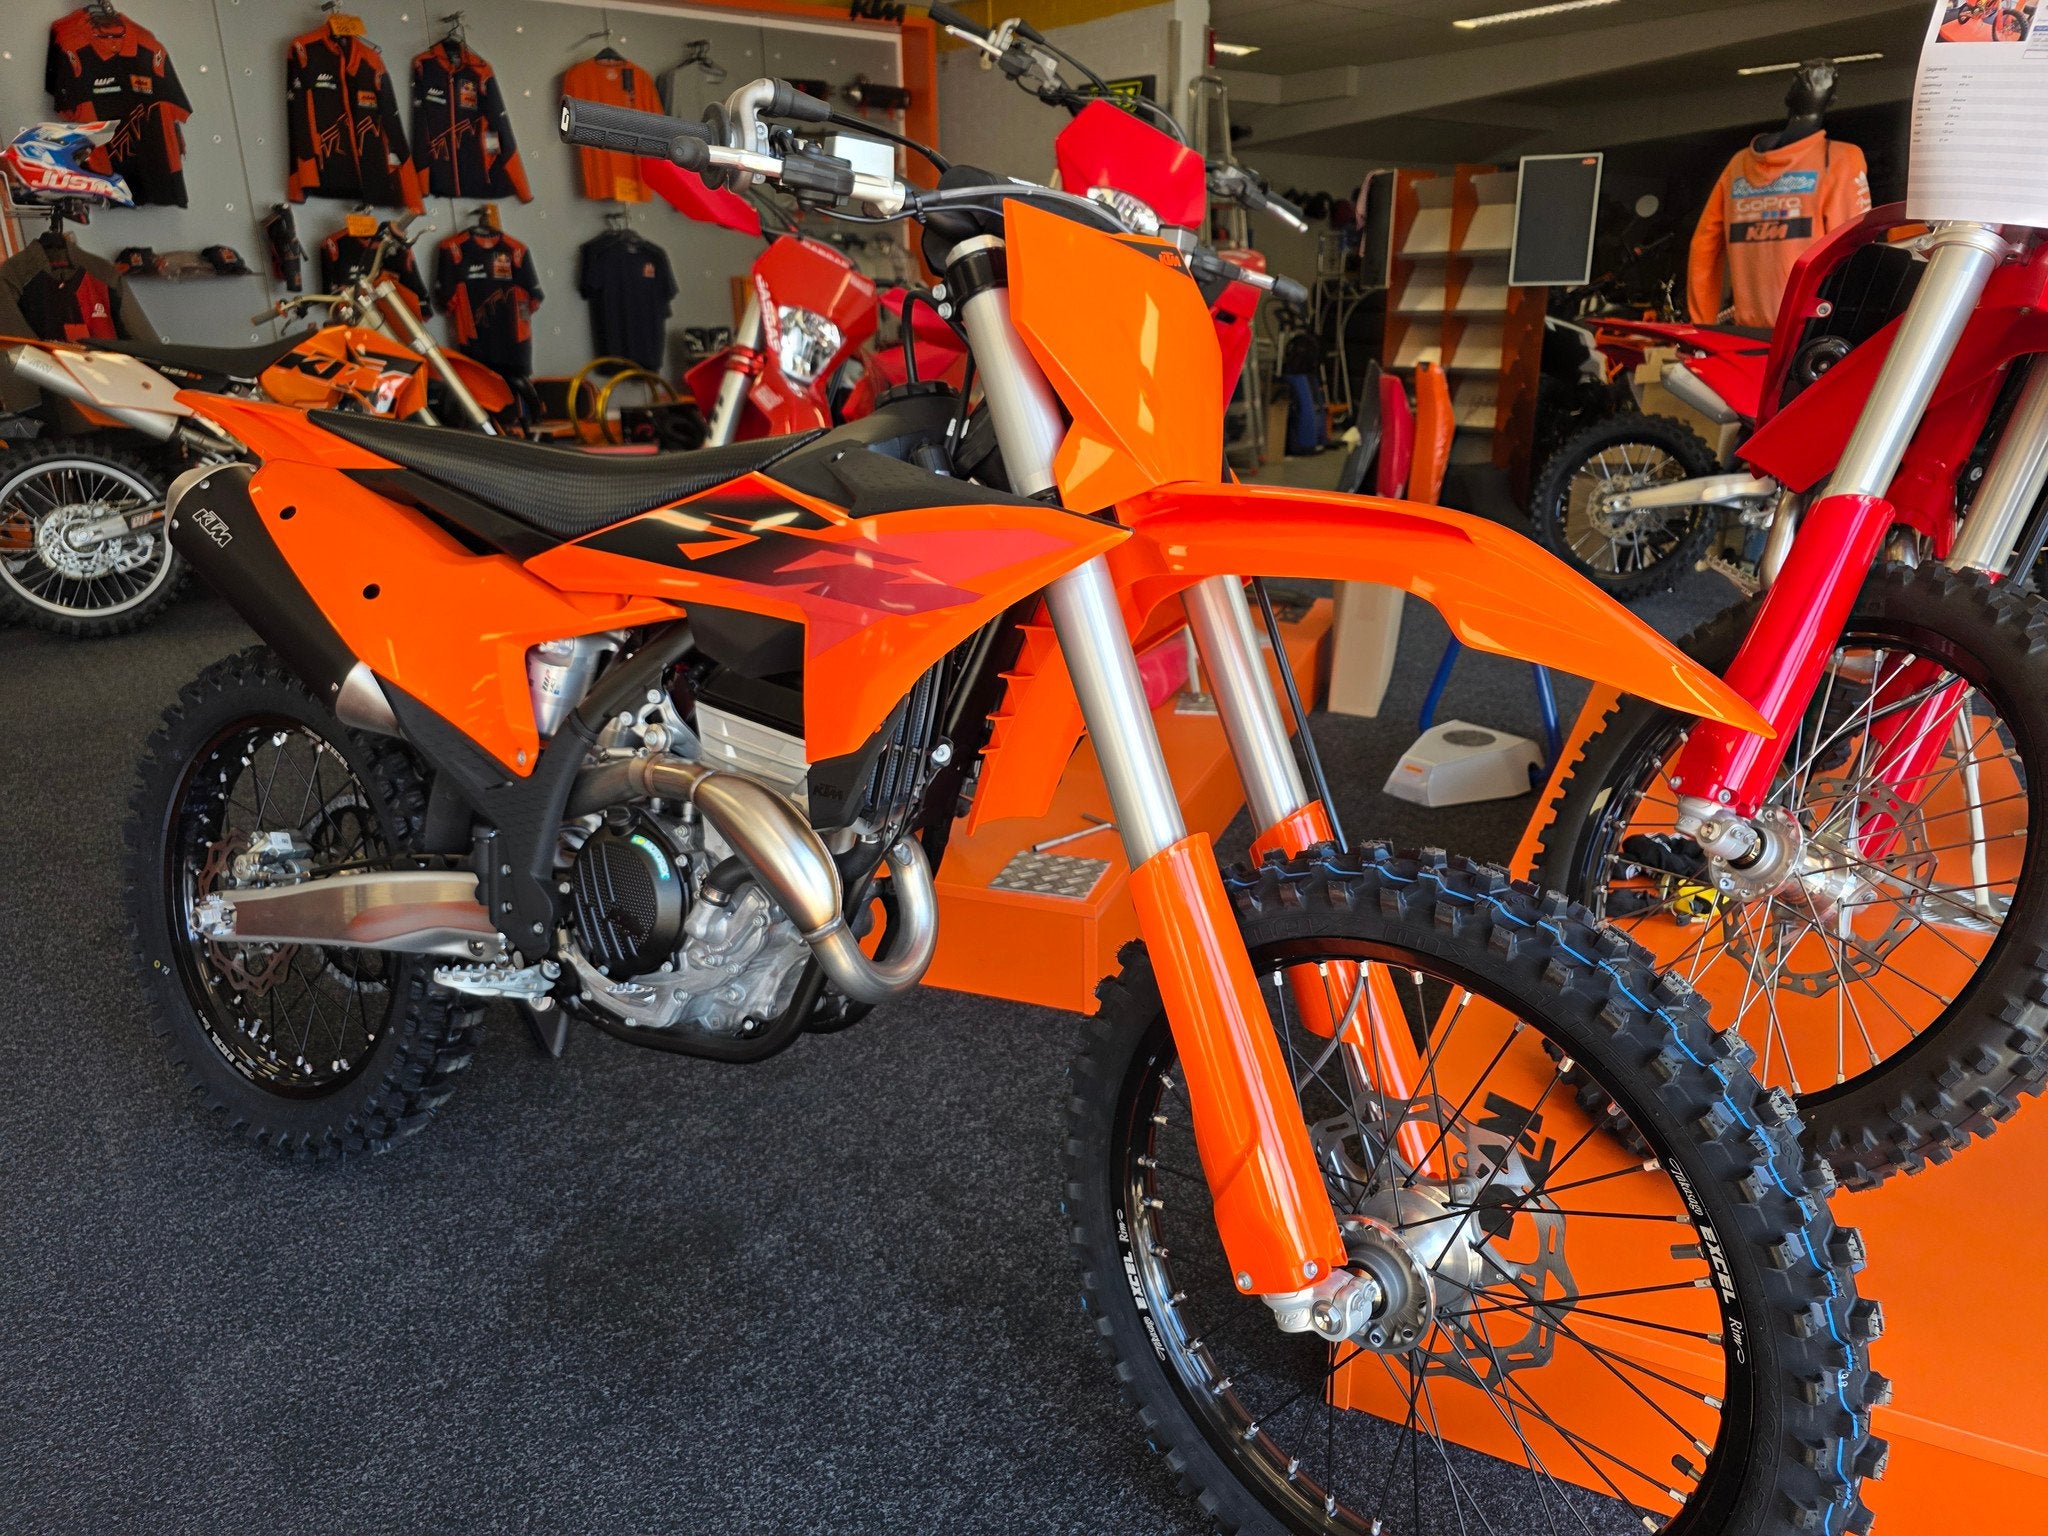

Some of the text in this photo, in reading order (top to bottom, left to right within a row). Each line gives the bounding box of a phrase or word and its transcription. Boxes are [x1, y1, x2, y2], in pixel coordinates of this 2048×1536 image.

[1737, 196, 1801, 213] GoPro
[1745, 221, 1789, 241] KTM
[1159, 251, 1181, 267] KTM
[192, 508, 233, 548] KTM
[1116, 1208, 1130, 1243] Rim
[1669, 1157, 1746, 1365] Takasago EXCEL Rim
[1123, 1251, 1149, 1310] EXCEL
